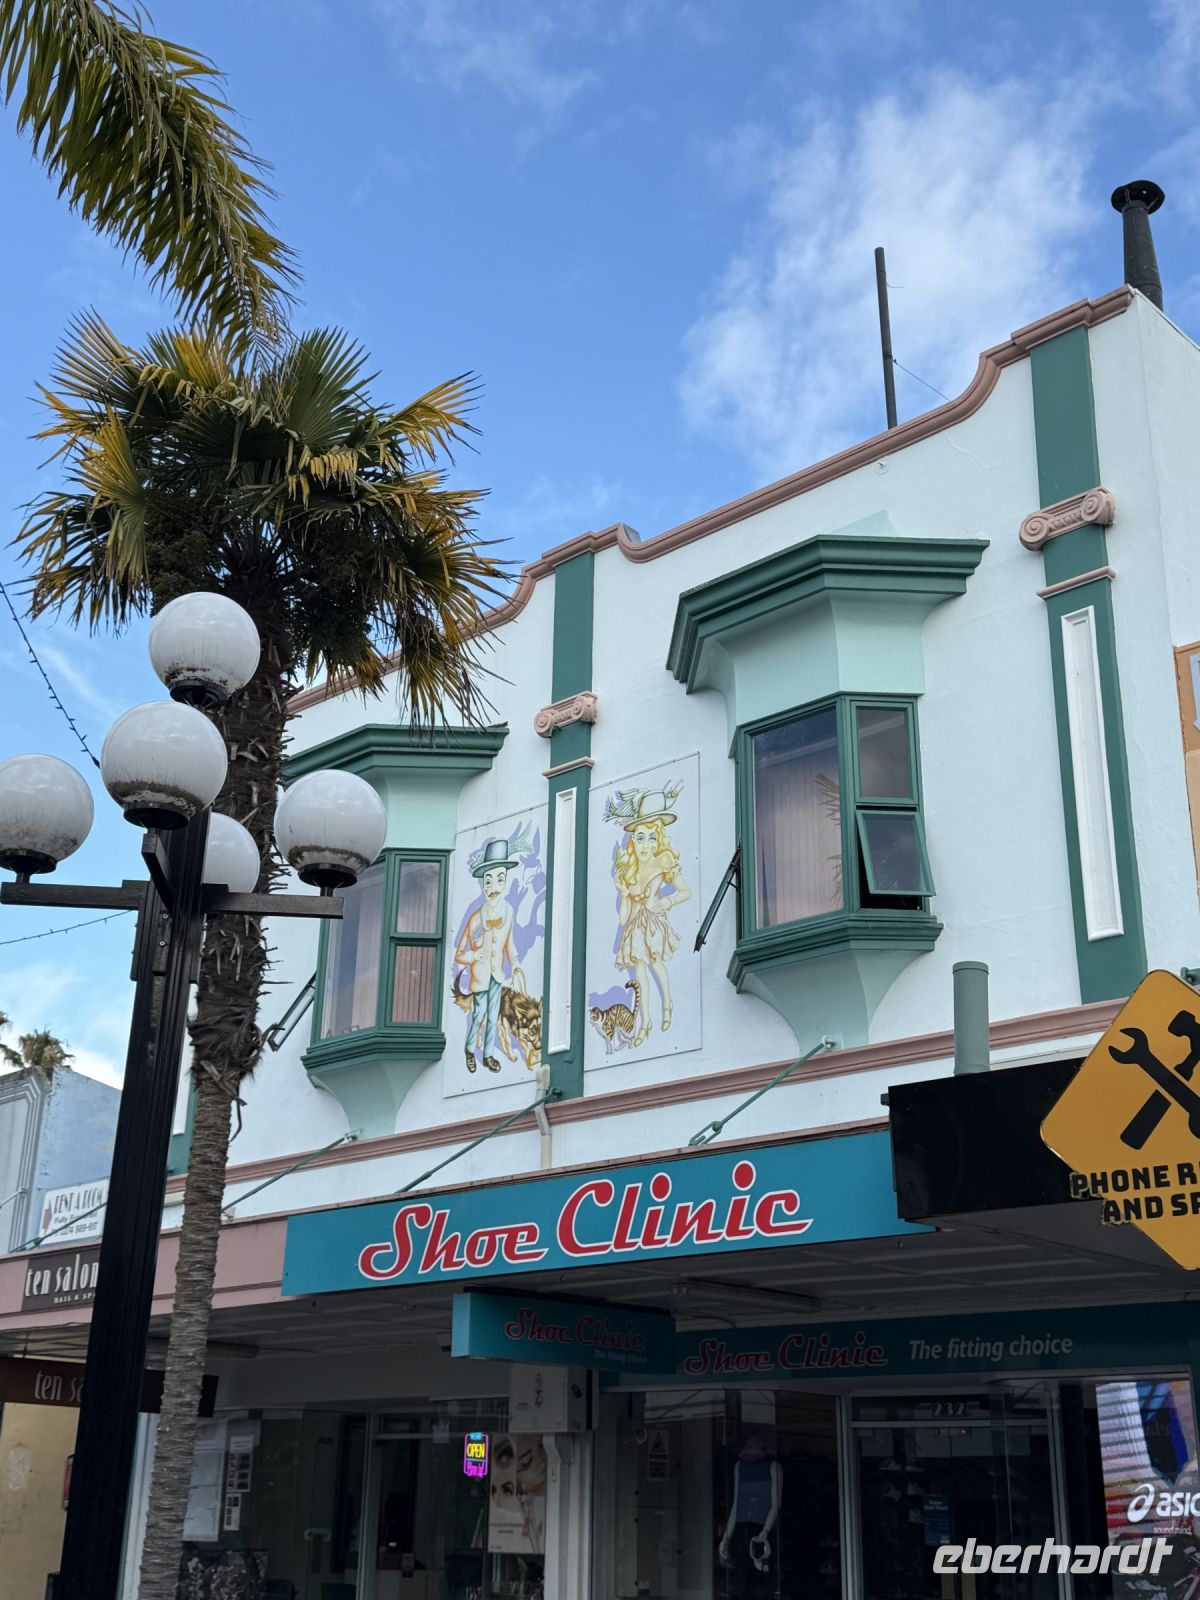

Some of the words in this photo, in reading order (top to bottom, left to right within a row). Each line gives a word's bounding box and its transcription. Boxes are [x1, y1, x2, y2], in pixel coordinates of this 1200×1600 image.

[1069, 1165, 1171, 1199] PHONE
[1177, 1161, 1200, 1186] R
[358, 1203, 548, 1281] Shoe
[556, 1160, 815, 1257] Clinic
[1102, 1195, 1164, 1224] AND
[25, 1268, 51, 1297] ten
[55, 1253, 99, 1293] salon
[504, 1306, 574, 1344] Shoe
[576, 1314, 648, 1352] Clinic
[682, 1338, 775, 1376] Shoe
[777, 1331, 889, 1371] Clinic
[909, 1339, 943, 1361] The
[947, 1336, 1004, 1362] fitting
[1009, 1333, 1074, 1356] choice
[34, 1370, 63, 1401] ten
[932, 1401, 965, 1418] 232
[466, 1443, 486, 1459] OPEN
